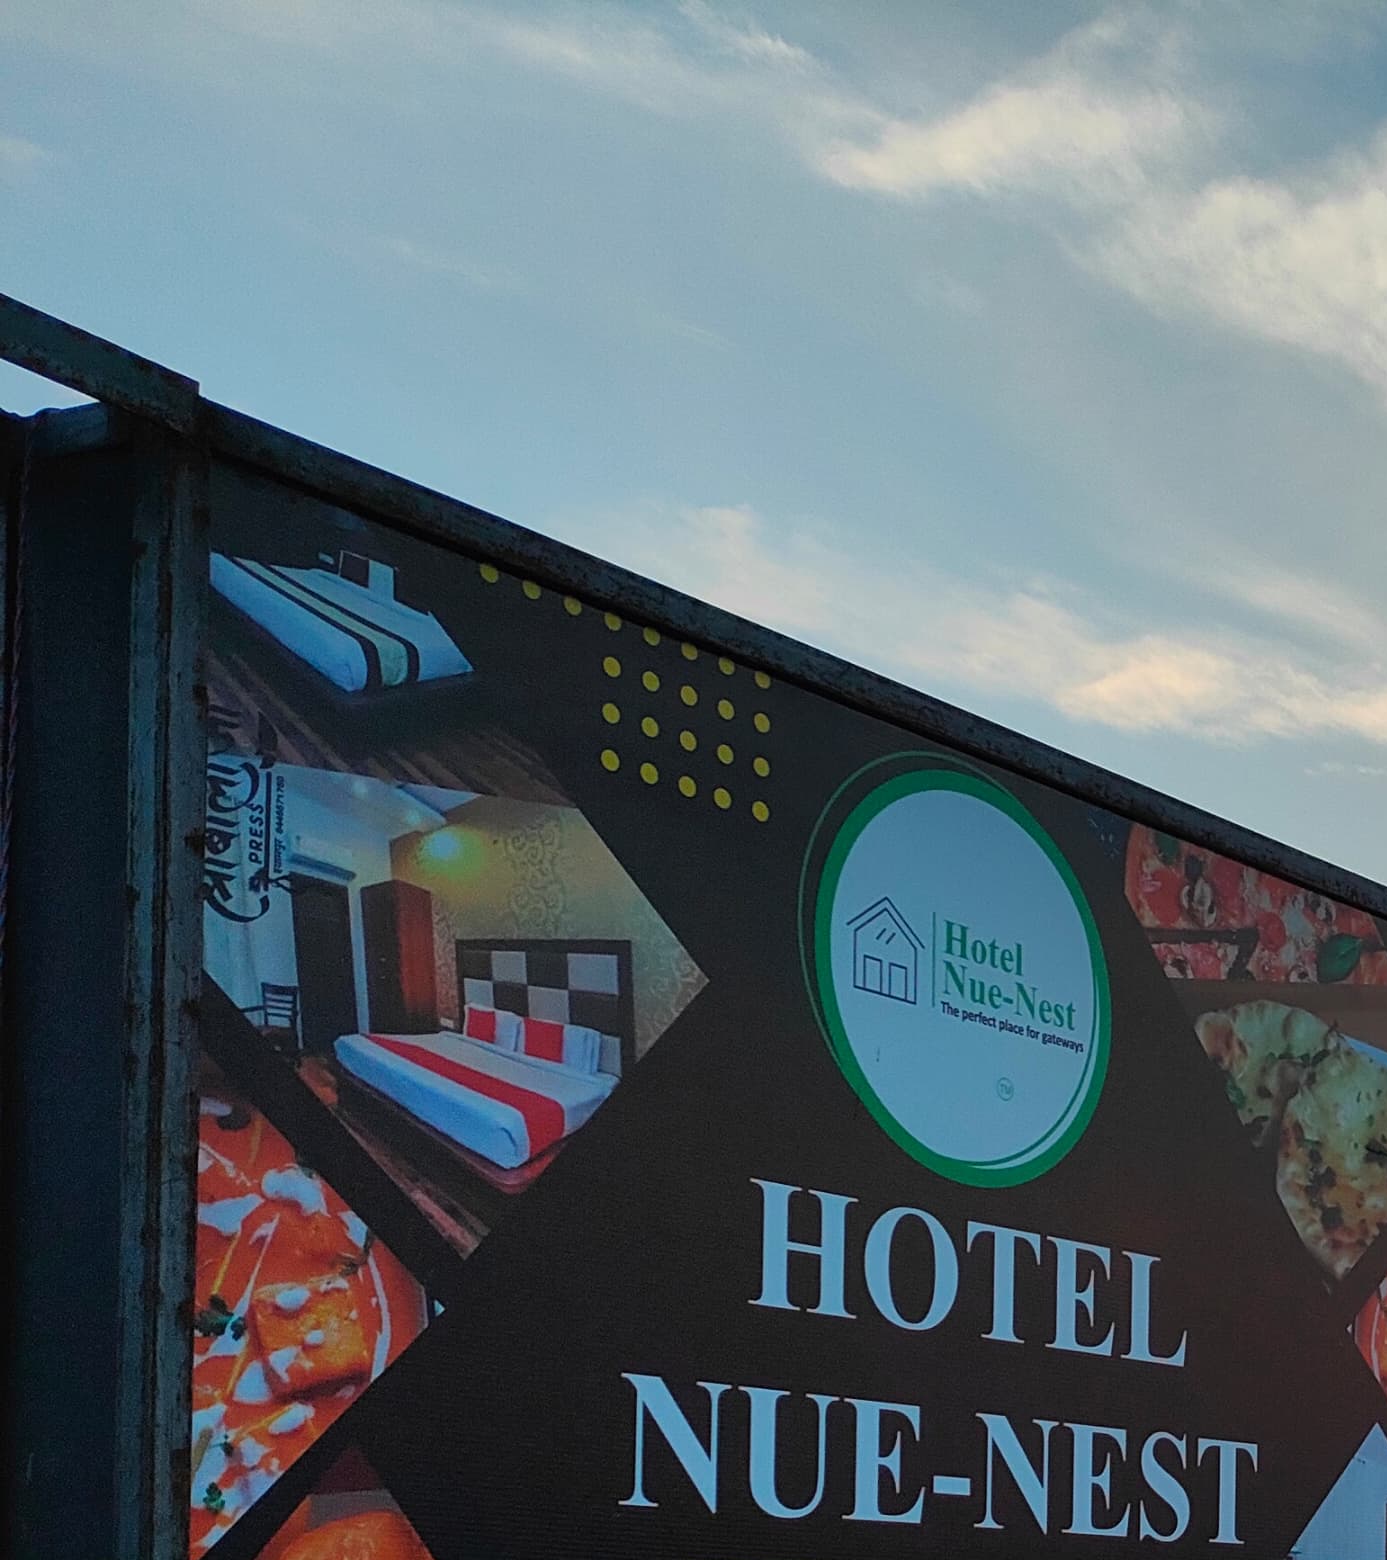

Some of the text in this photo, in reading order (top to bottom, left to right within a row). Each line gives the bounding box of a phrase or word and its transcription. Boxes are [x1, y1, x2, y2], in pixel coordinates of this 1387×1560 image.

[248, 802, 264, 864] PRESS
[944, 919, 1023, 976] Hotel
[941, 1001, 1084, 1054] The perfect place for gateways
[943, 960, 1076, 1031] Nue-Nest
[748, 1178, 1188, 1367] HOTEL
[619, 1373, 1258, 1544] NUE-NEST
